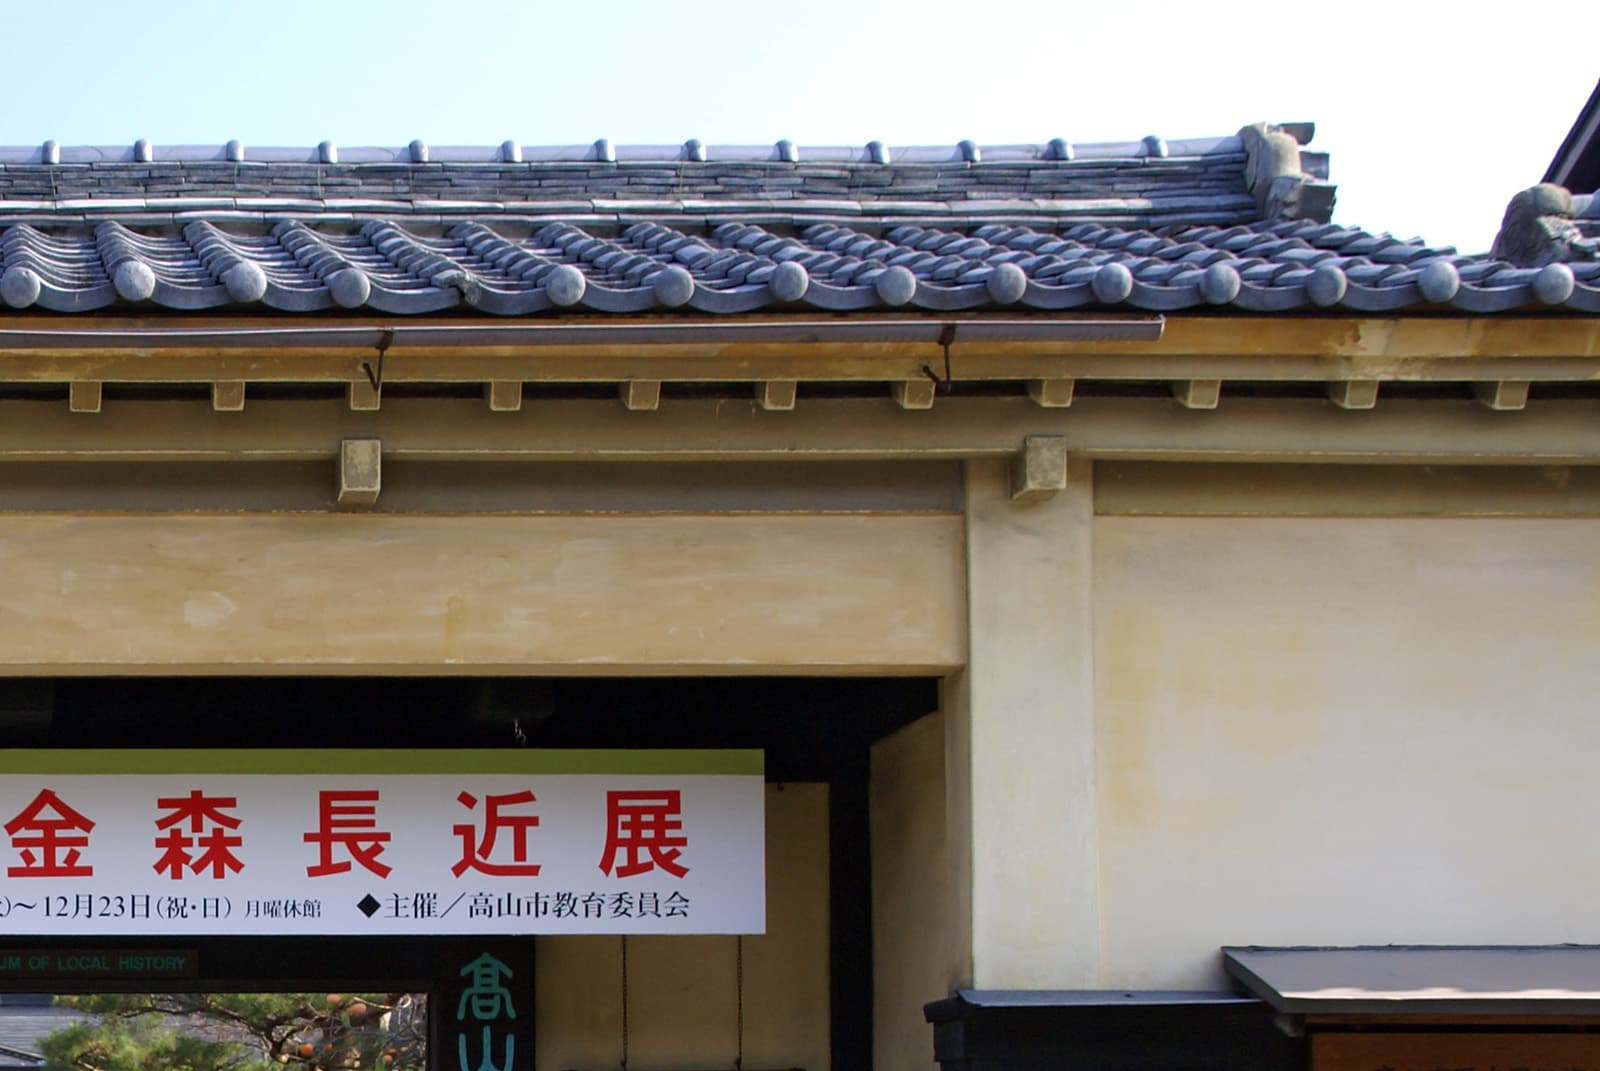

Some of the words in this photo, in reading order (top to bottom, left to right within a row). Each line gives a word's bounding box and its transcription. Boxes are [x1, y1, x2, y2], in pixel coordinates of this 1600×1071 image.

[3, 788, 690, 880] 金森長近展
[244, 899, 322, 919] 月曜休館
[28, 956, 50, 970] OF
[57, 956, 111, 970] LOCAL
[119, 956, 186, 970] HISTORY
